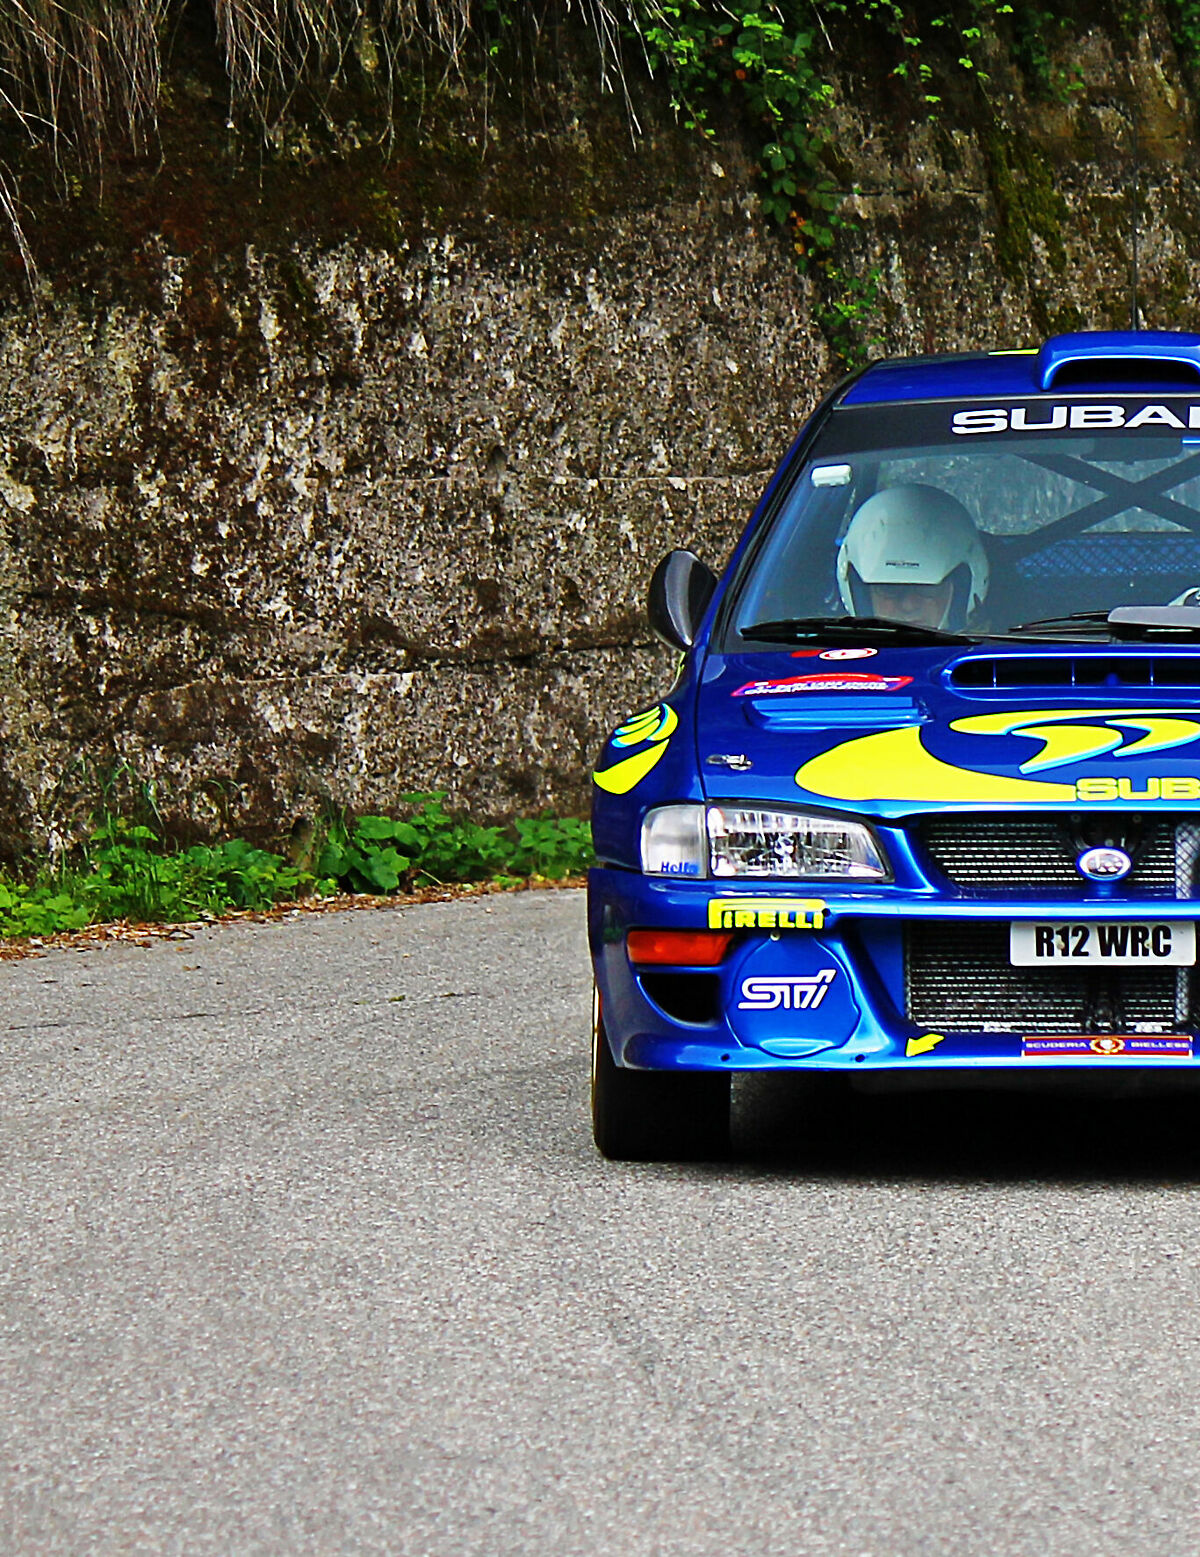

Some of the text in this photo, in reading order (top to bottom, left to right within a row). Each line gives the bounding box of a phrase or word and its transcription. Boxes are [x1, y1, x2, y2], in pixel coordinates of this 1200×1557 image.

[708, 898, 826, 929] PIRELLI
[1035, 925, 1172, 957] R12 WRC
[1025, 1041, 1088, 1049] SCUDERIA
